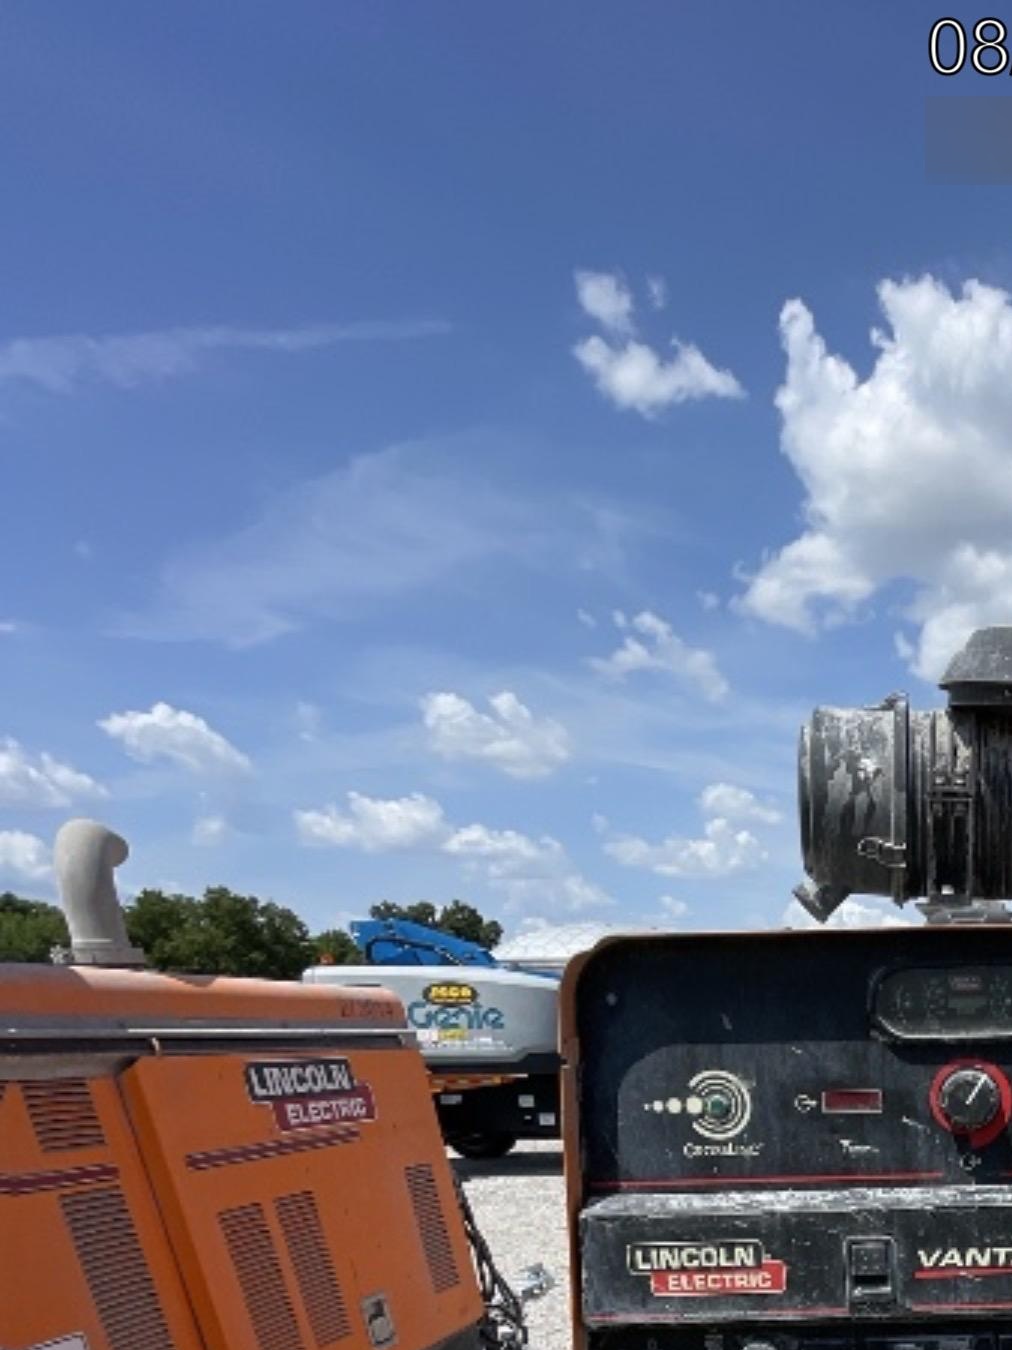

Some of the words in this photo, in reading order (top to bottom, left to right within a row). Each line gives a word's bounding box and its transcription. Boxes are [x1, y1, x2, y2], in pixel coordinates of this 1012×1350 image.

[408, 1001, 504, 1030] Genie
[249, 1064, 352, 1097] LINCOLN
[286, 1098, 367, 1125] ELECTRIC
[635, 1246, 756, 1270] LINCOLN
[667, 1271, 772, 1291] ELECTRIC
